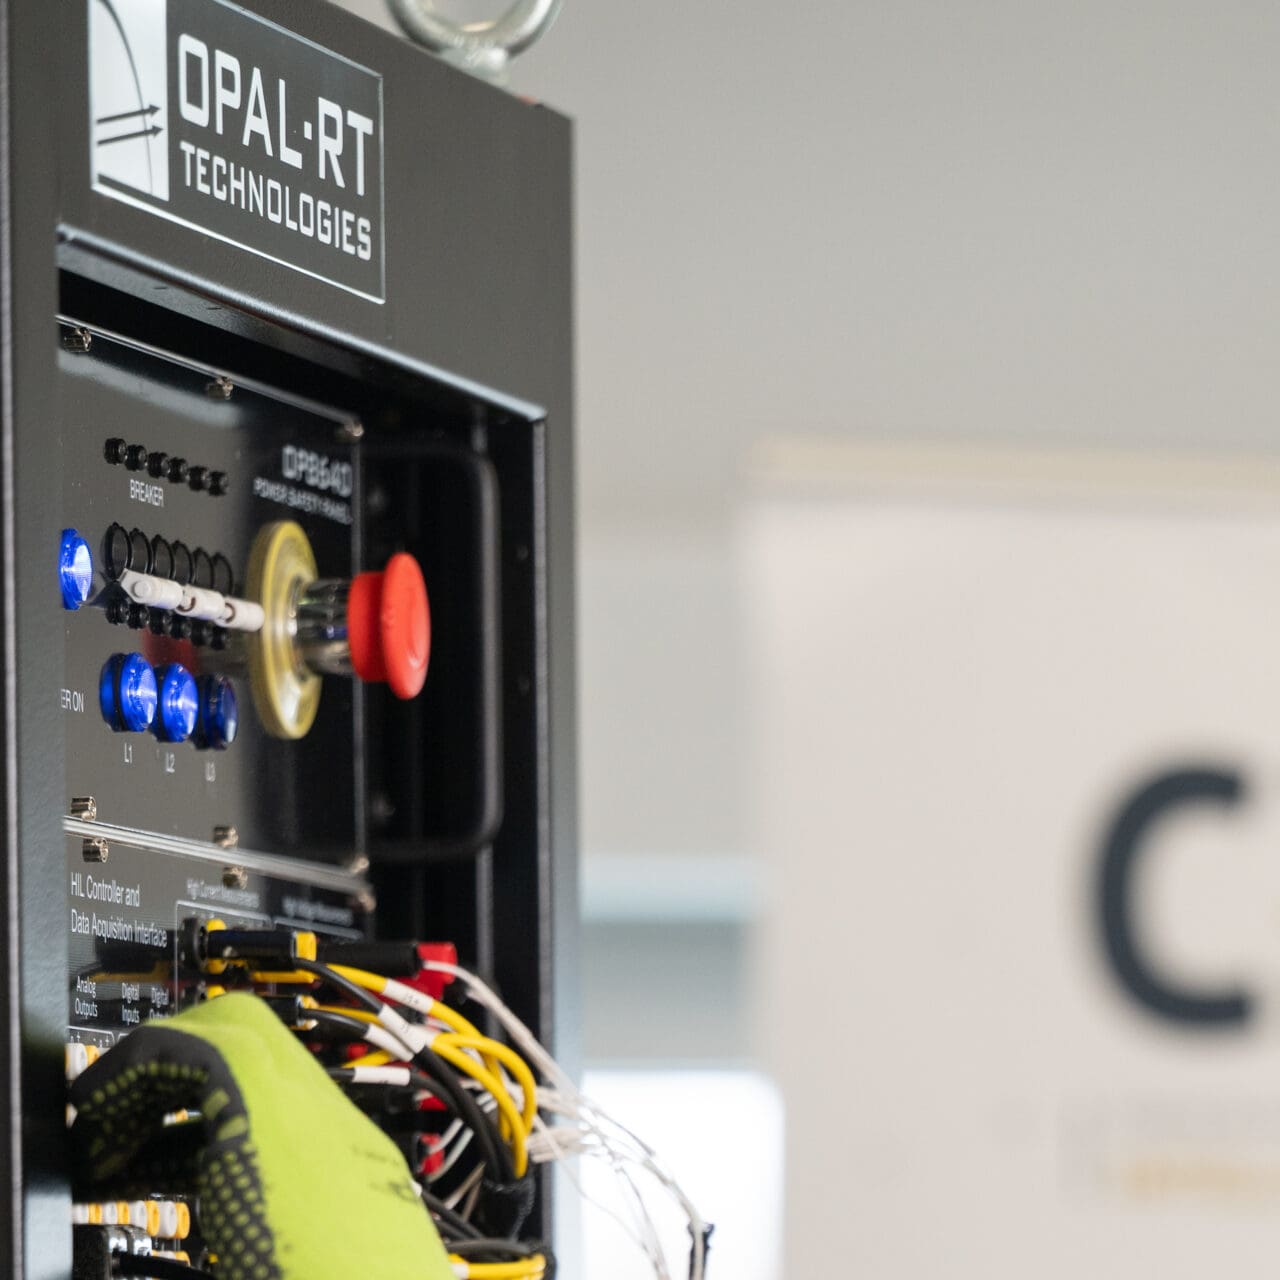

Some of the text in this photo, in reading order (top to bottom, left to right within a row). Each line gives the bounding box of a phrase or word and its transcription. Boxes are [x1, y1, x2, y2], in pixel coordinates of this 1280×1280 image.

[180, 142, 372, 261] TECHNOLOGIES
[129, 479, 165, 508] BREAKER
[72, 692, 85, 712] ON
[124, 743, 133, 764] L1
[165, 752, 175, 773] L2
[71, 872, 141, 907] HIL Controller and
[71, 908, 168, 948] Data Acquisition Interface
[76, 975, 97, 998] Analog
[121, 982, 140, 1004] Digital
[75, 998, 98, 1019] Outputs
[121, 1005, 140, 1025] Inputs
